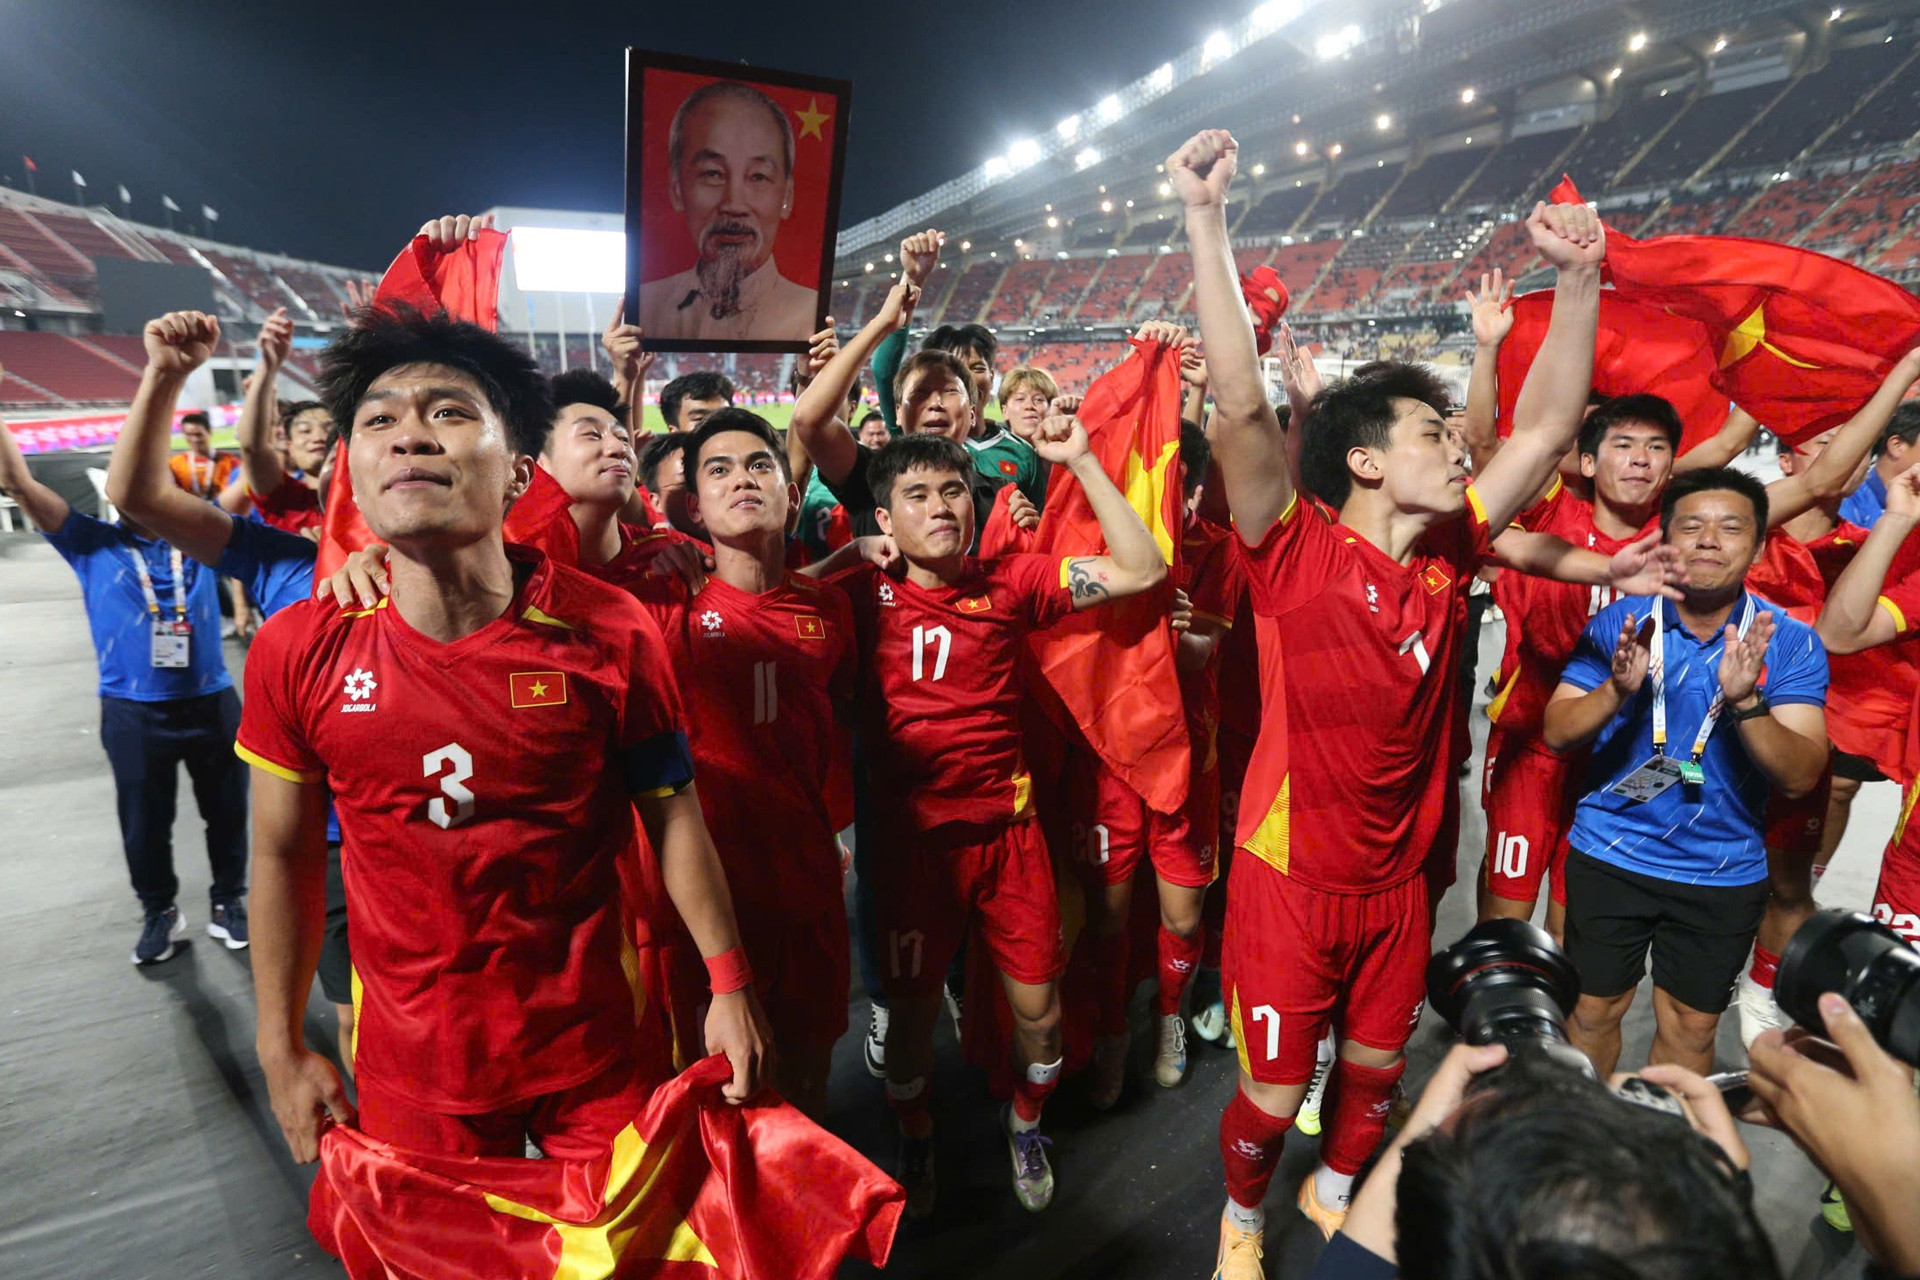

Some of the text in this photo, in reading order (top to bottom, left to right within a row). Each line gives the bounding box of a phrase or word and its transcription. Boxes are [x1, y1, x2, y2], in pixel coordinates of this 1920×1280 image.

[912, 625, 952, 682] 17
[1399, 630, 1431, 676] 7
[753, 661, 778, 724] 11
[423, 742, 475, 830] 3
[1494, 831, 1530, 879] 10
[888, 929, 925, 980] 17
[1251, 1004, 1281, 1061] 7
